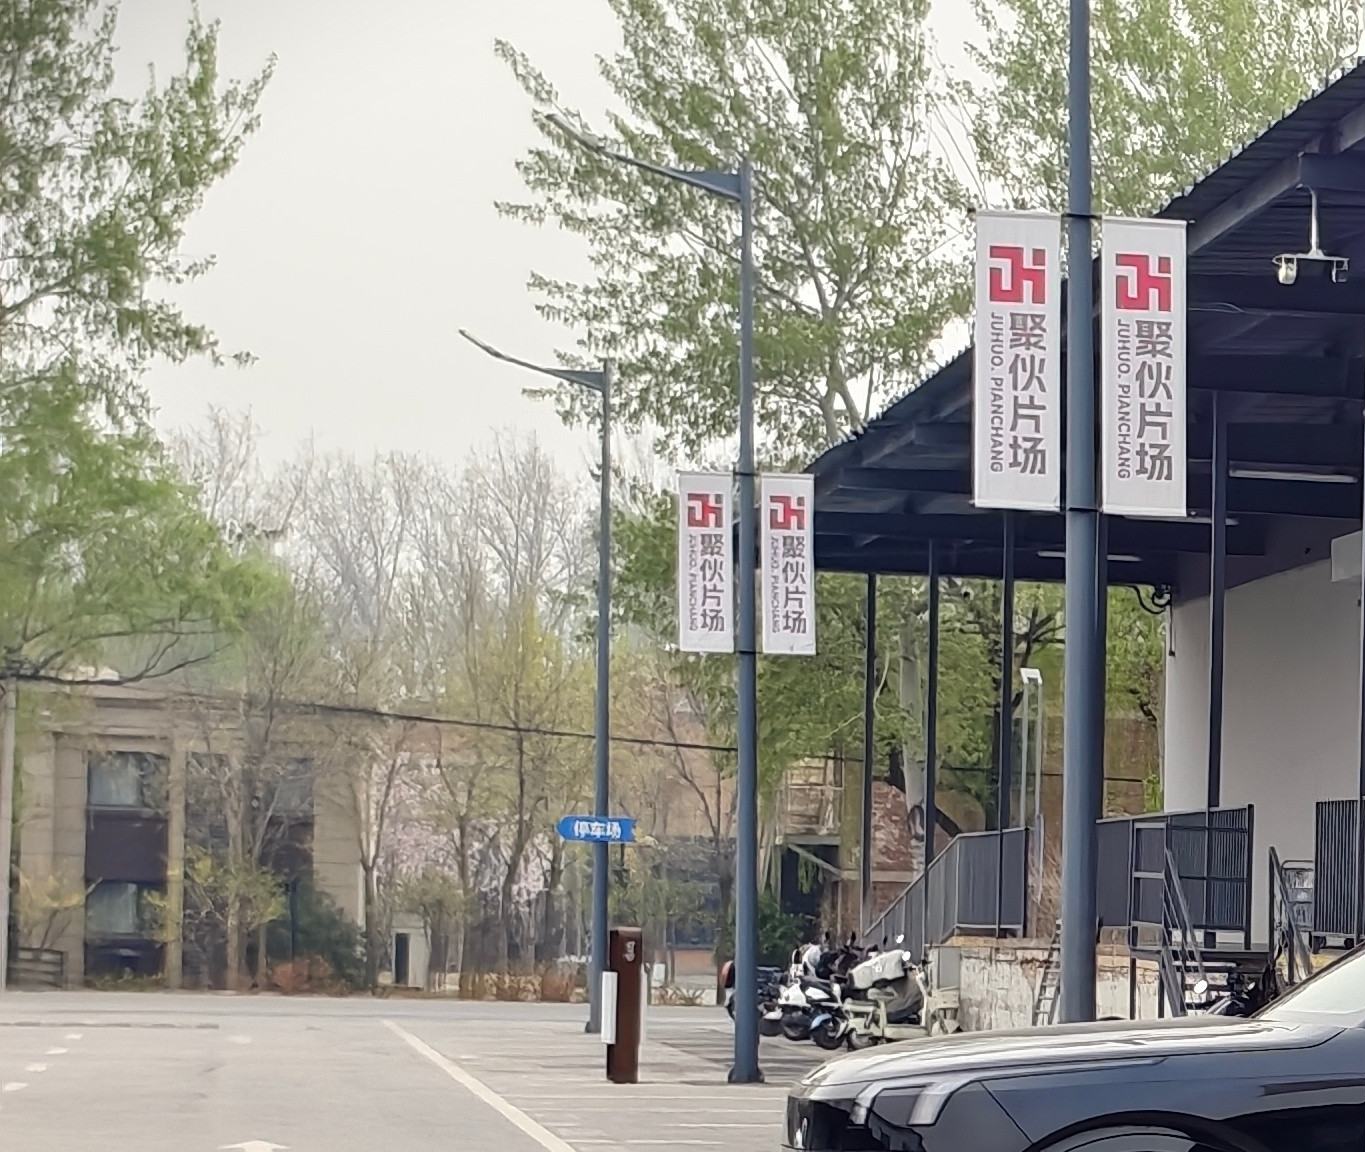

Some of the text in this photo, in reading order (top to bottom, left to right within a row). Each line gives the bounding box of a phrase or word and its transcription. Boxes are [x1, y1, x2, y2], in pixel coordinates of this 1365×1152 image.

[990, 377, 1004, 473] PIANCHANG
[1008, 312, 1047, 475] 聚伙片场
[1117, 384, 1131, 479] PIANCHANG
[1135, 320, 1173, 480] 聚伙片场
[700, 534, 725, 632] 聚伙片场
[782, 535, 807, 634] 聚伙片场
[573, 819, 622, 839] 停车场
